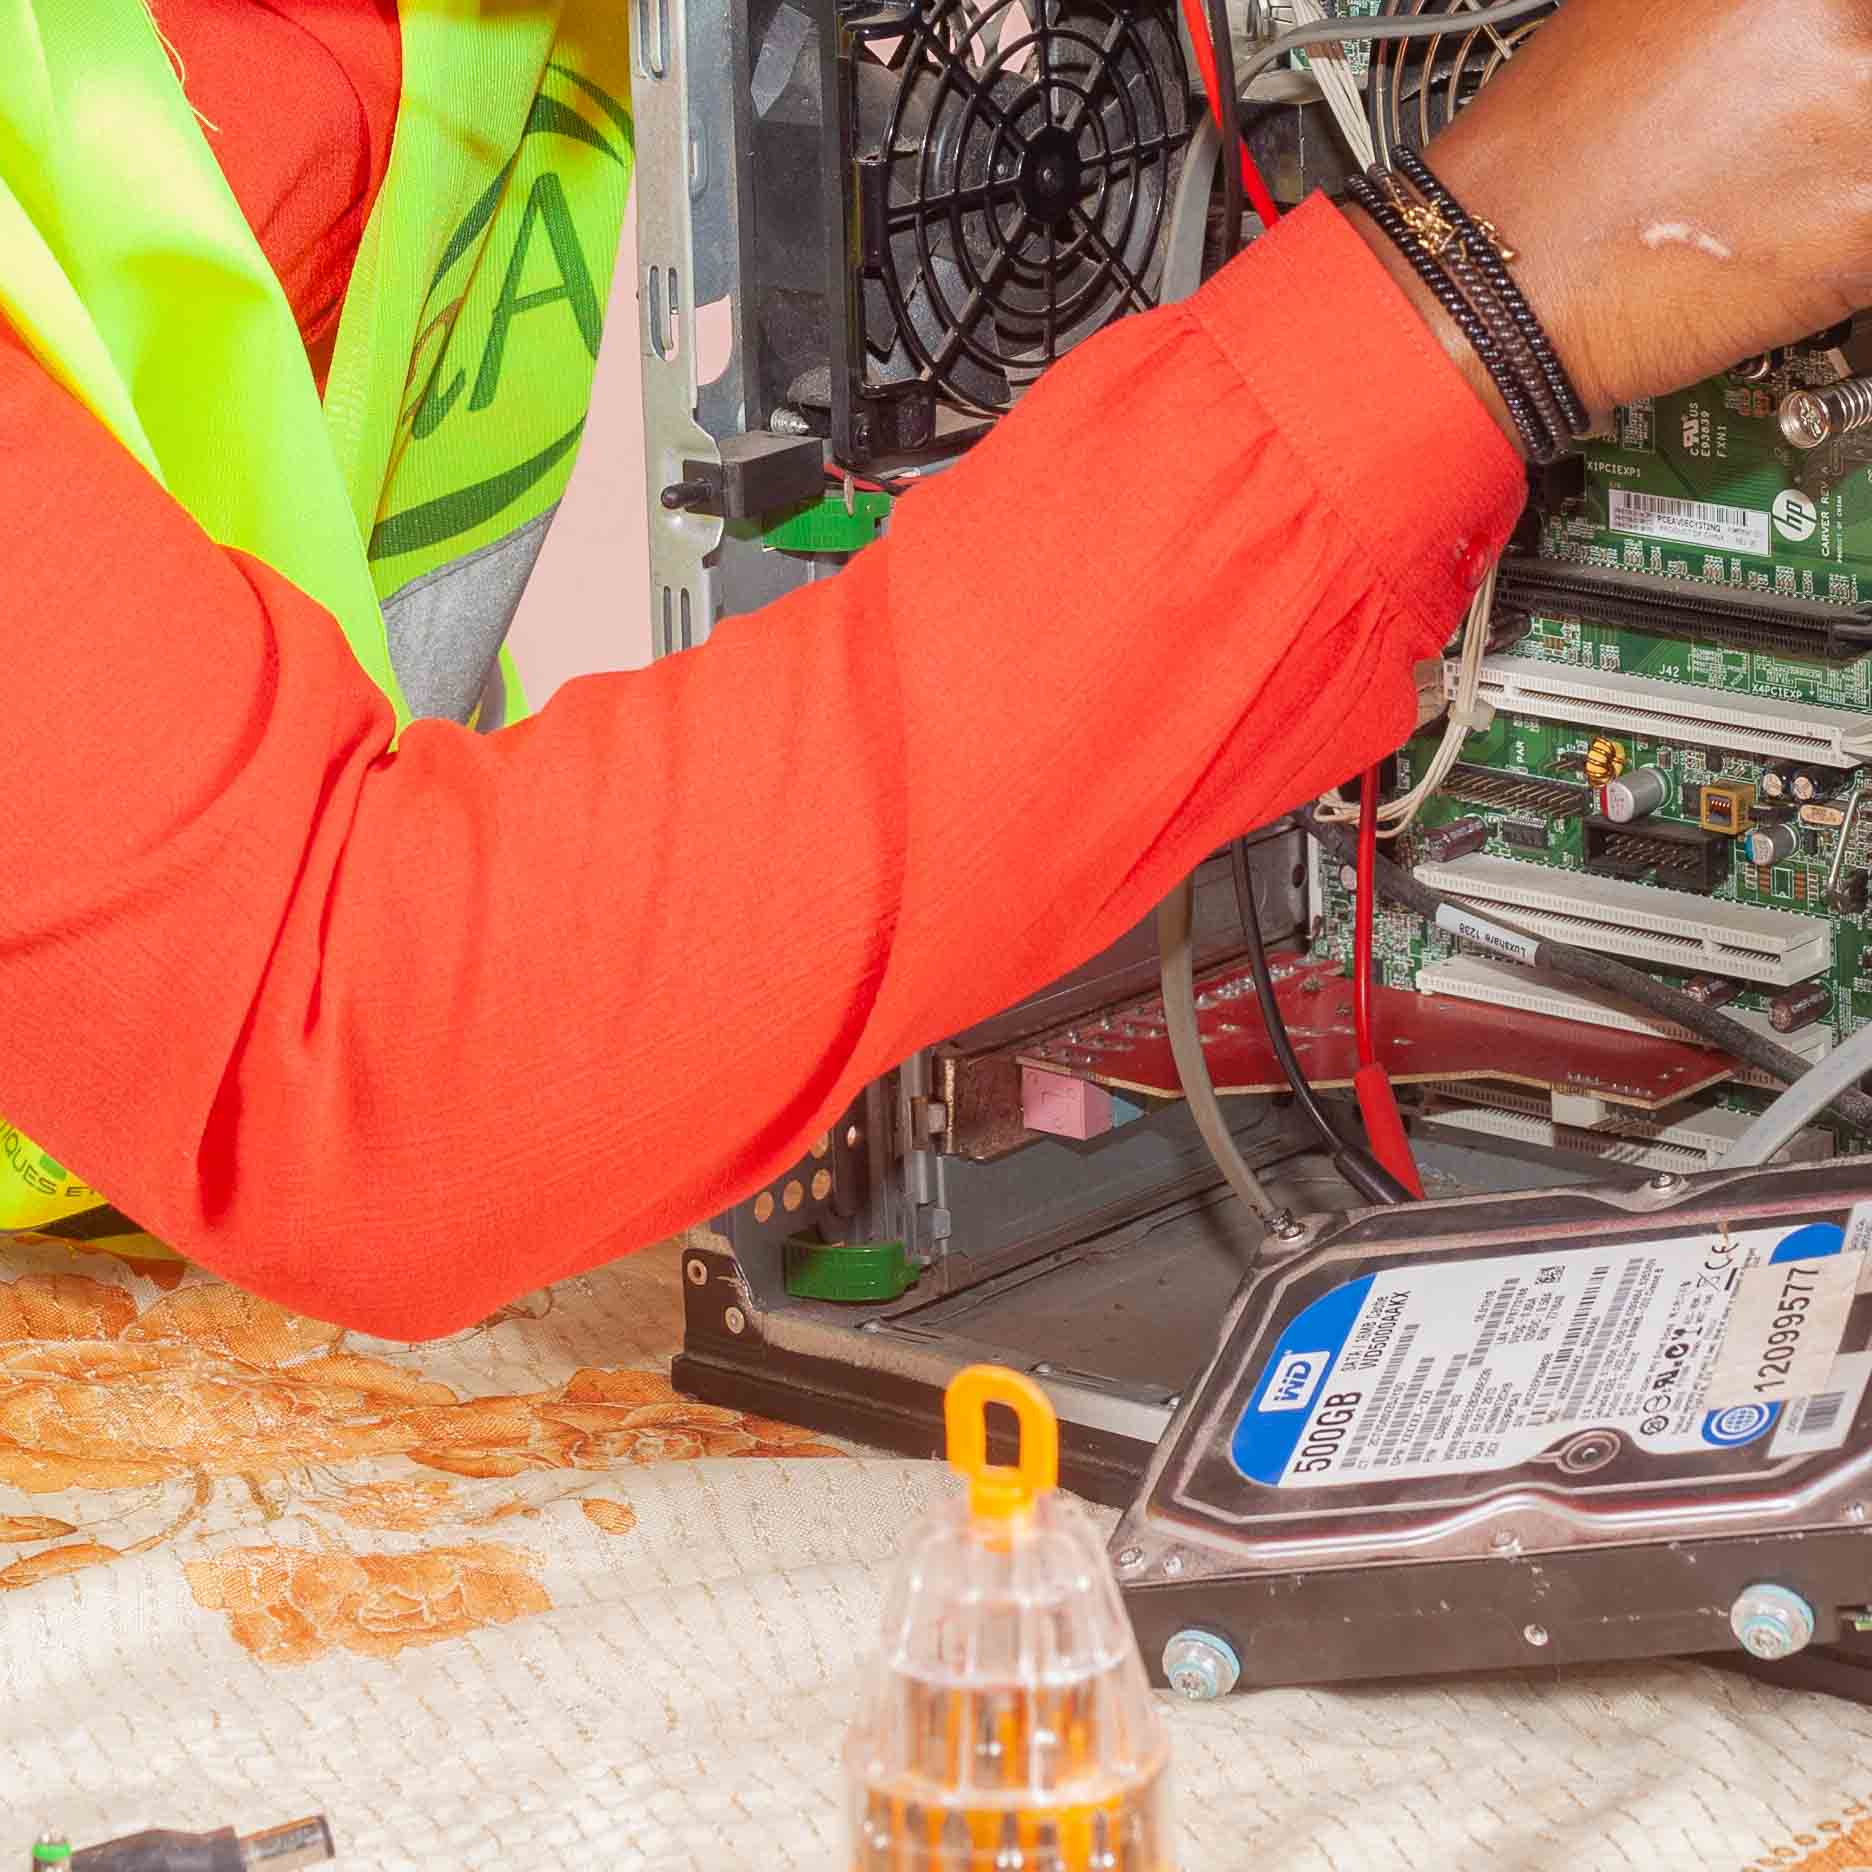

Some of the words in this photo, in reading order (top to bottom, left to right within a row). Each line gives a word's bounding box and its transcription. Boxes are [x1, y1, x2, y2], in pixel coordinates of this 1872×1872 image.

[1820, 511, 1830, 557] CARVER
[1659, 665, 1680, 678] J42
[1359, 1290, 1410, 1368] WD5000AAKX
[1753, 1267, 1819, 1392] 12099577
[1292, 1391, 1362, 1472] 500GB
